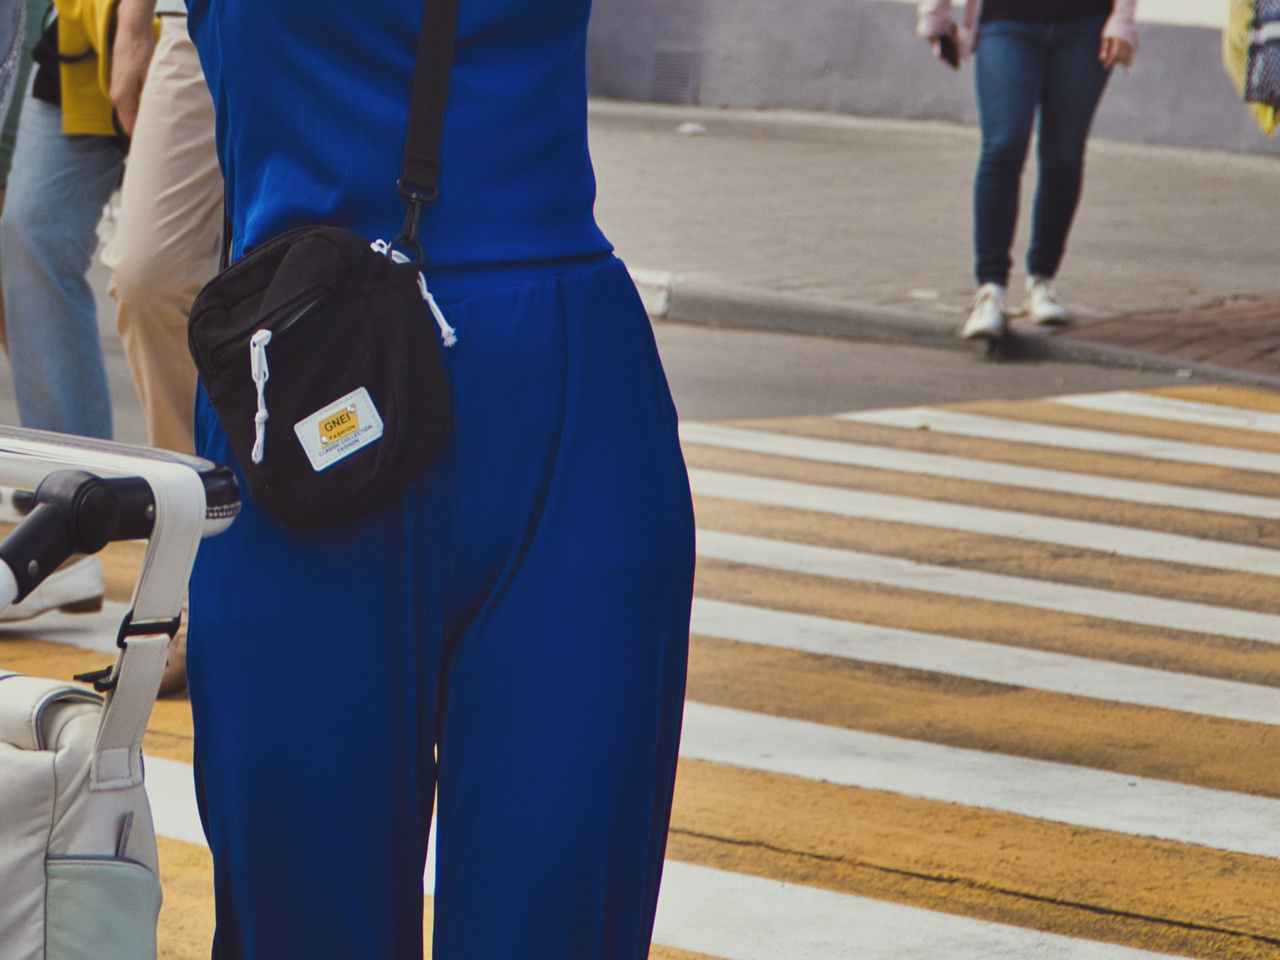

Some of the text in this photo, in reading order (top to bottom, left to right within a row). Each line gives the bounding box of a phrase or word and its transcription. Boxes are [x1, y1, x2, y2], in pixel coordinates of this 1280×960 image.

[324, 412, 351, 432] GNEI
[318, 424, 373, 457] CLASSIC COLLECTION
[329, 424, 356, 440] FASHION
[337, 438, 360, 453] FASHION
